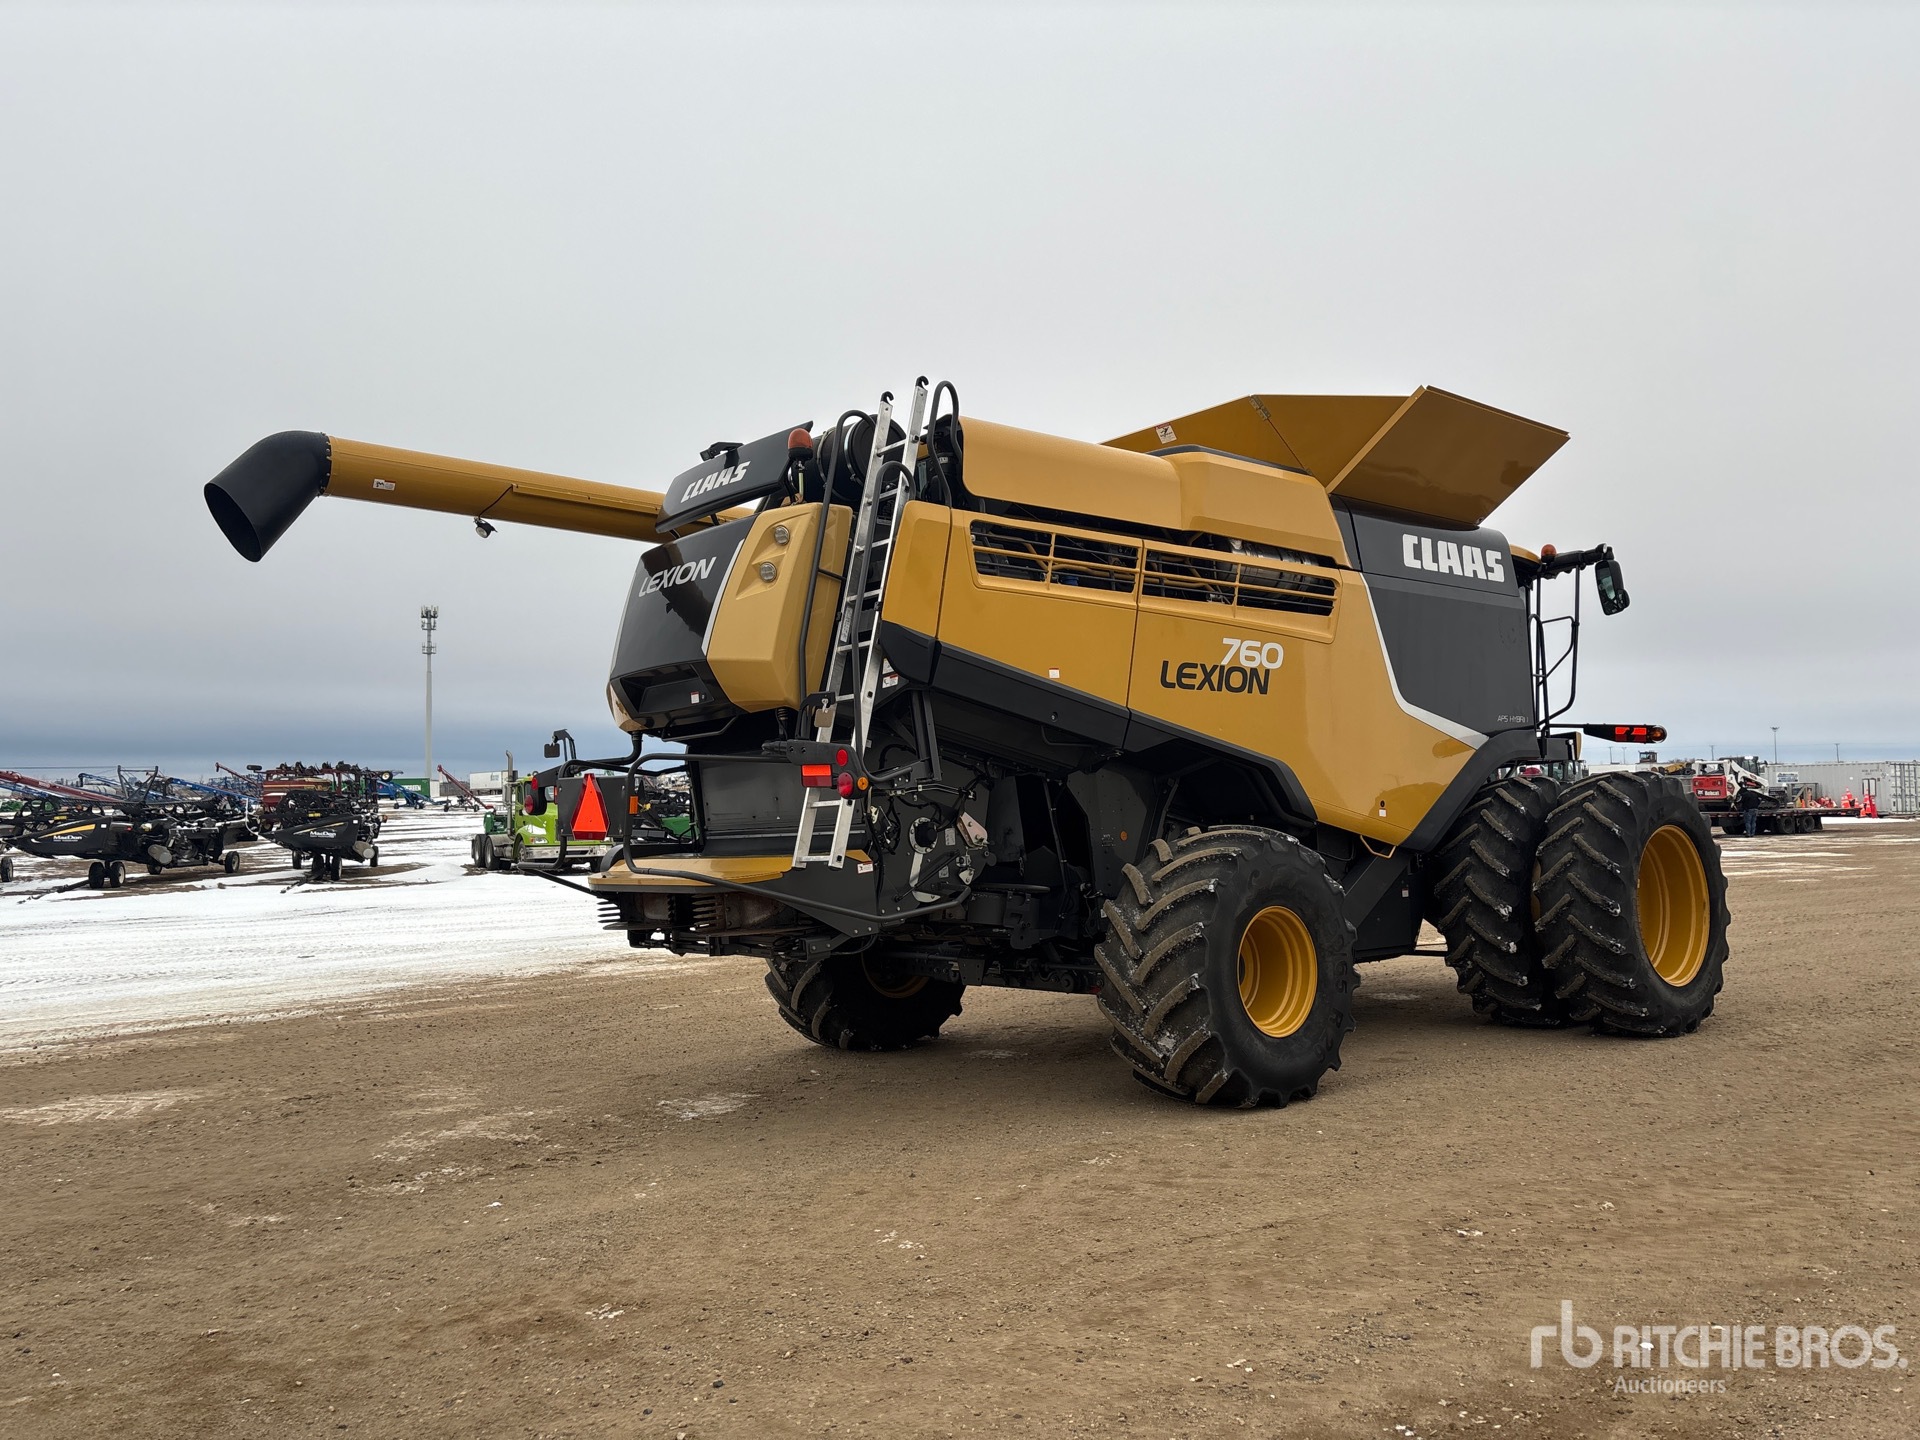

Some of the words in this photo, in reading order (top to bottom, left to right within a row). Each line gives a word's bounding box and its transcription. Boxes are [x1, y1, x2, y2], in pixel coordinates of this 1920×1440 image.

[681, 461, 751, 503] CLAAS
[639, 556, 717, 597] LEXION
[1402, 533, 1505, 582] CLAAS
[1220, 637, 1284, 669] 760
[1160, 660, 1270, 695] LEXION
